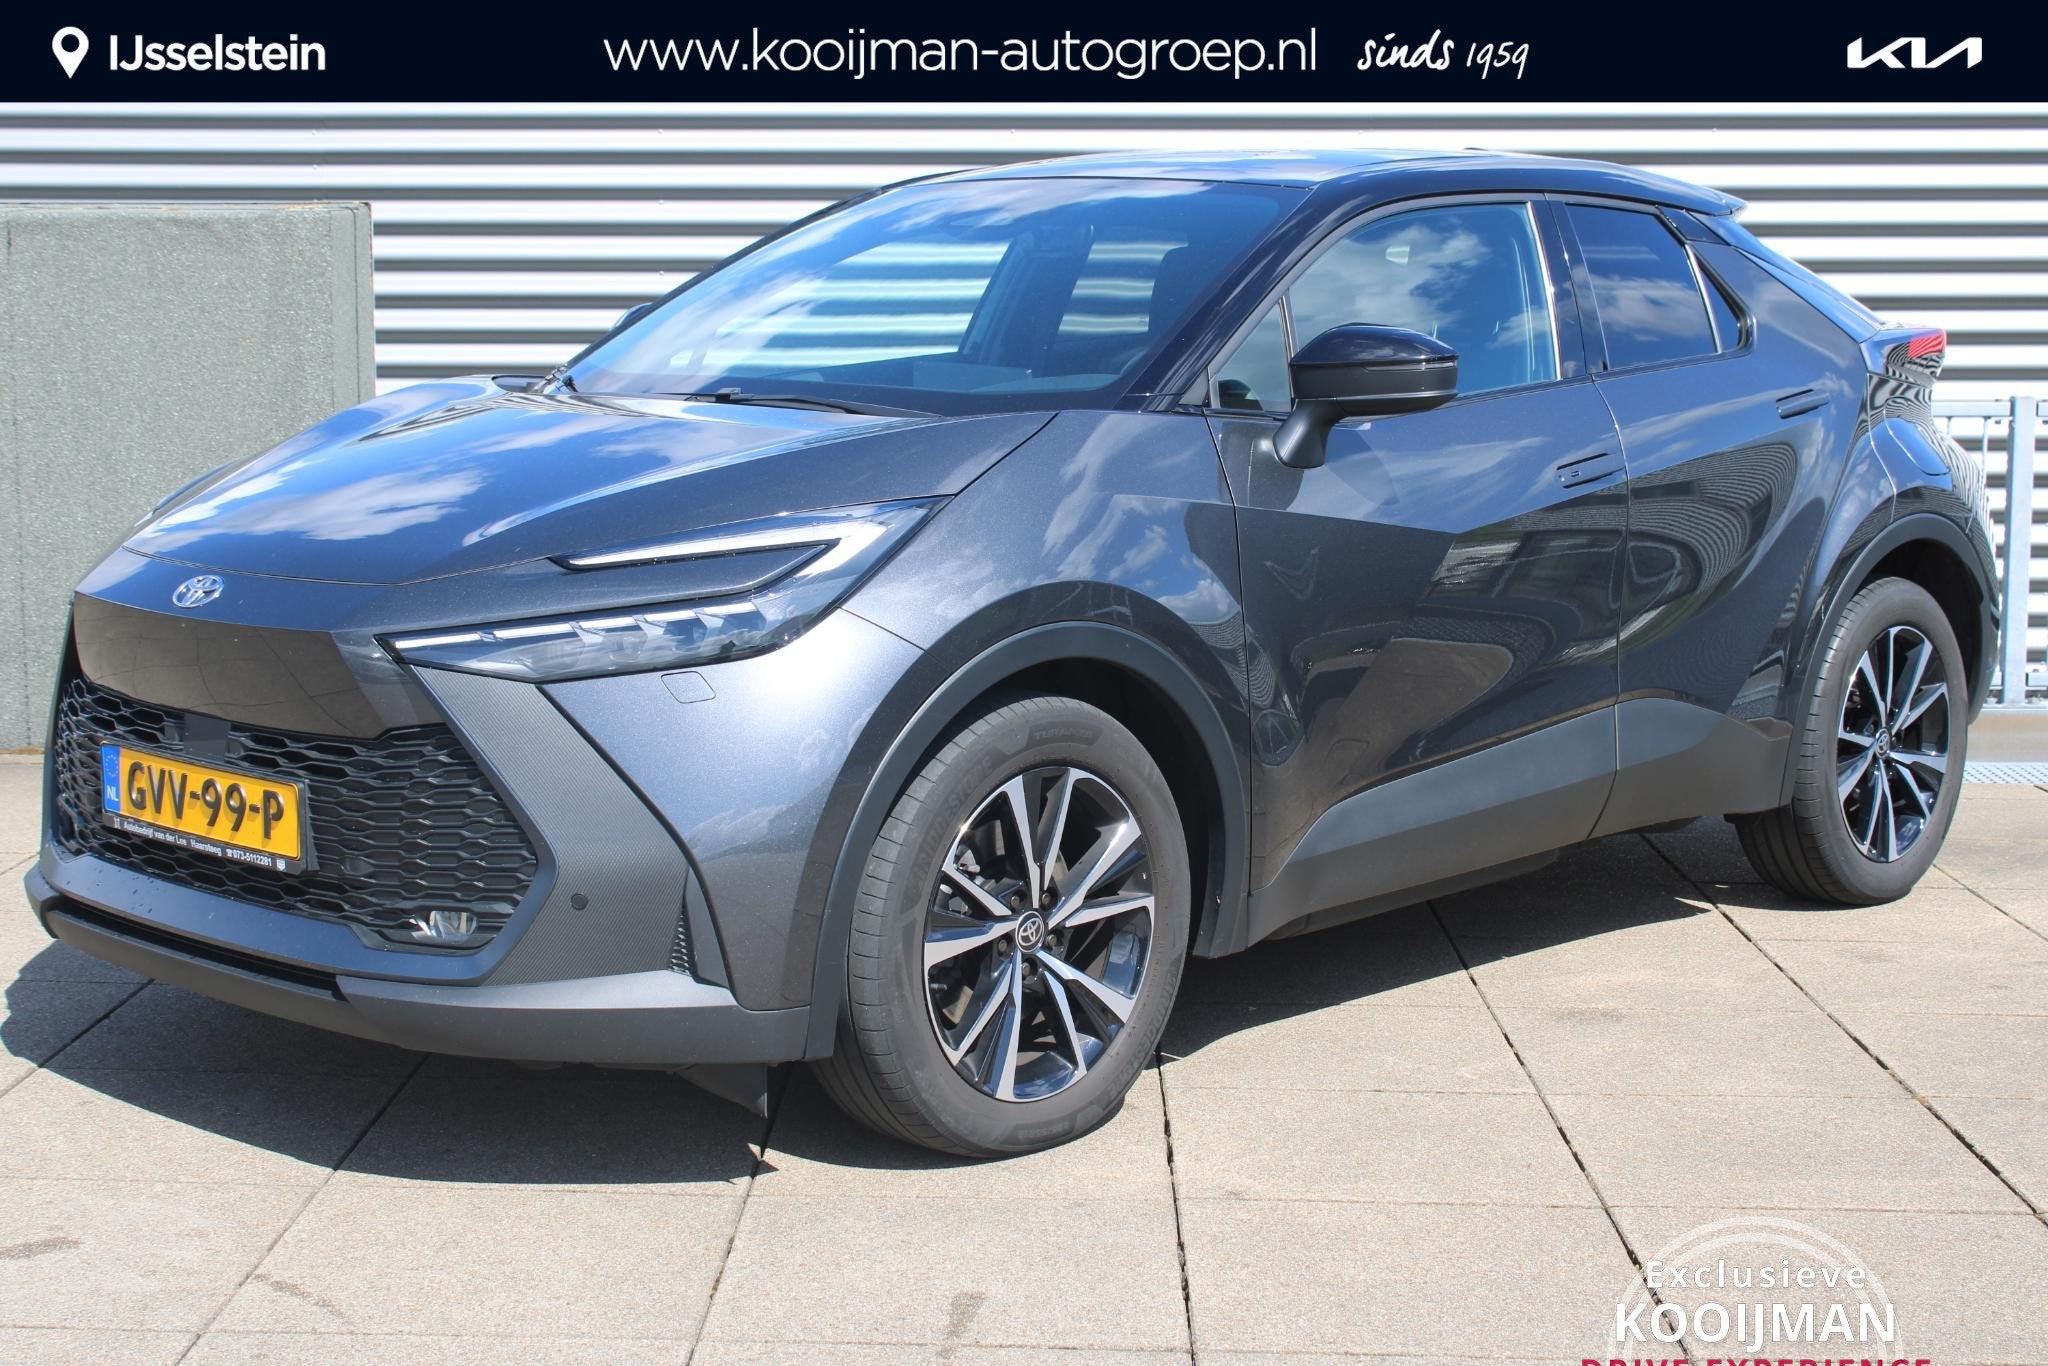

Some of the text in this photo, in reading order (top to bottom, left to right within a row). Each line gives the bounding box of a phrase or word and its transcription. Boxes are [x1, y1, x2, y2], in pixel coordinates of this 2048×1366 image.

[105, 784, 119, 802] NL
[129, 761, 285, 840] GVV-99-P
[154, 830, 166, 841] van
[165, 832, 176, 843] der
